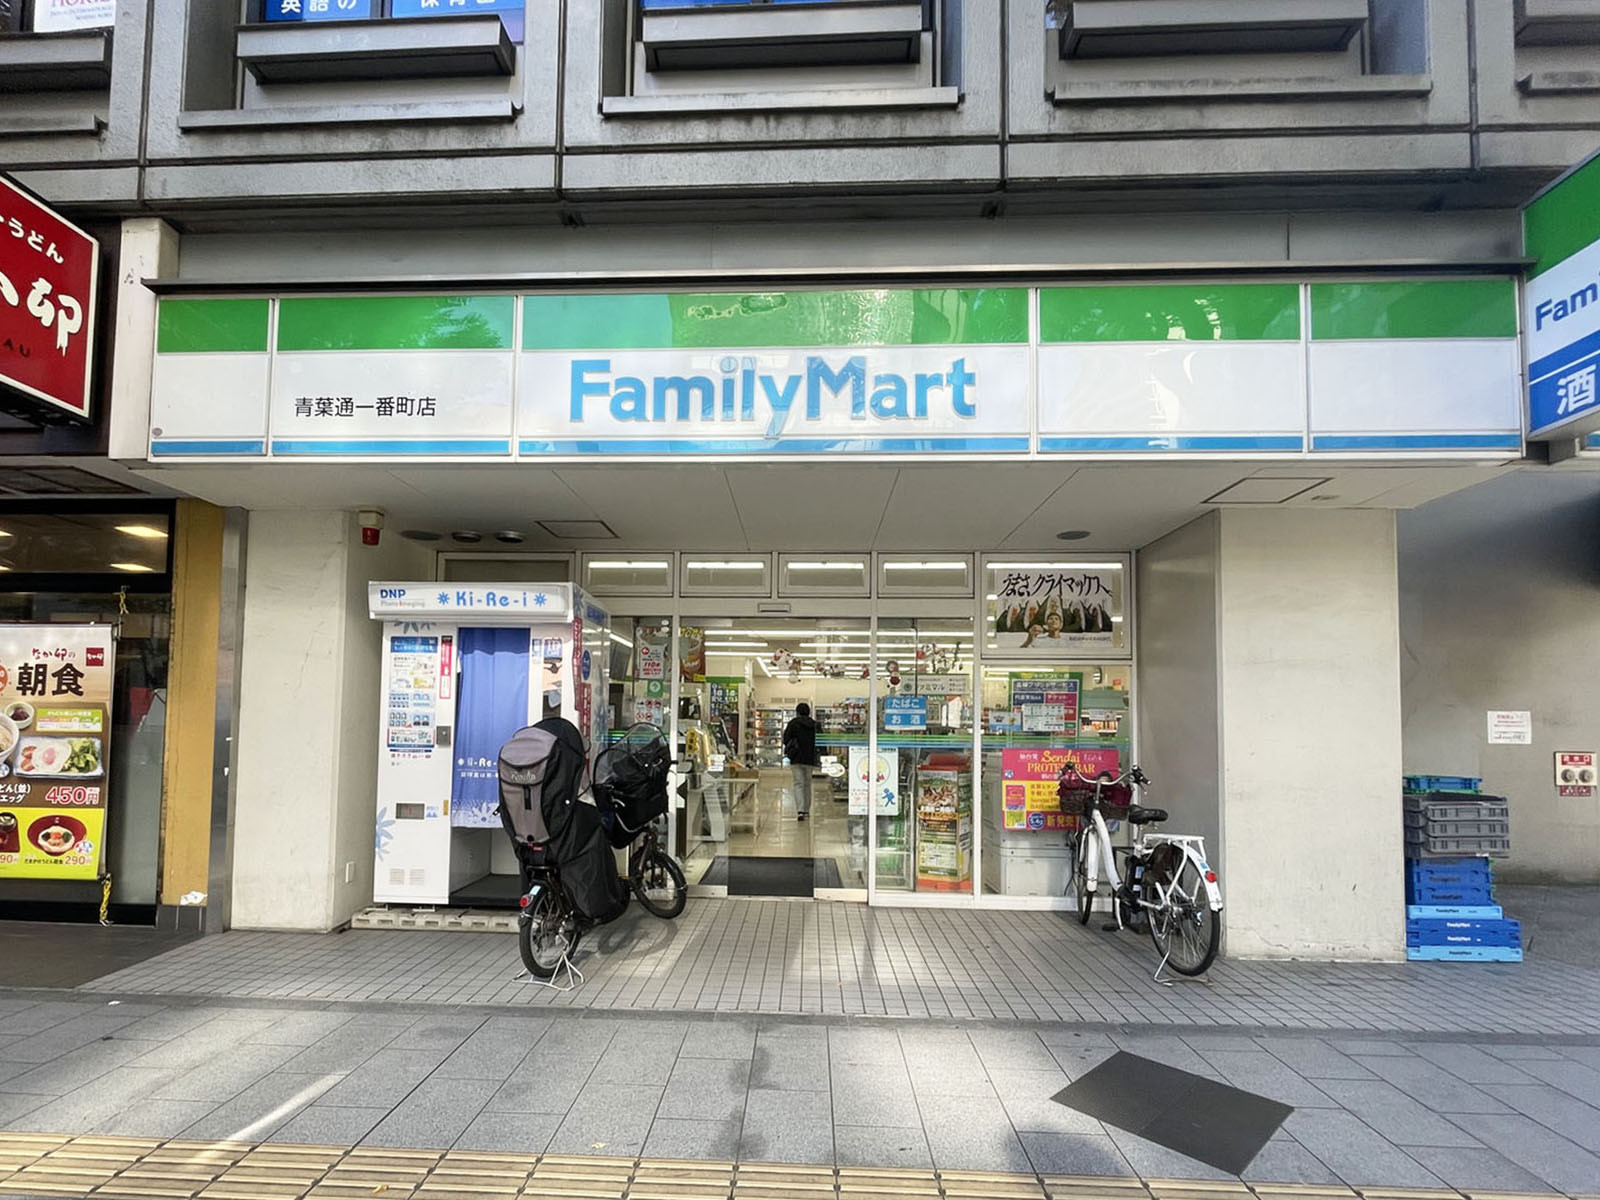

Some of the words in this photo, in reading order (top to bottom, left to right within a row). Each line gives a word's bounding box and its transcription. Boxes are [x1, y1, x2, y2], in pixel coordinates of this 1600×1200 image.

[0, 214, 64, 264] うどん
[1536, 271, 1600, 331] Fam
[569, 356, 977, 440] FamilyMart
[1557, 364, 1597, 415] 酒
[295, 397, 437, 418] 青葉通一番町店
[380, 589, 406, 599] DNP
[456, 591, 527, 607] Ki-Re-i
[16, 663, 84, 696] 朝食
[891, 698, 920, 709] たばこ
[1040, 749, 1081, 763] Sendai
[45, 786, 100, 805] 450円
